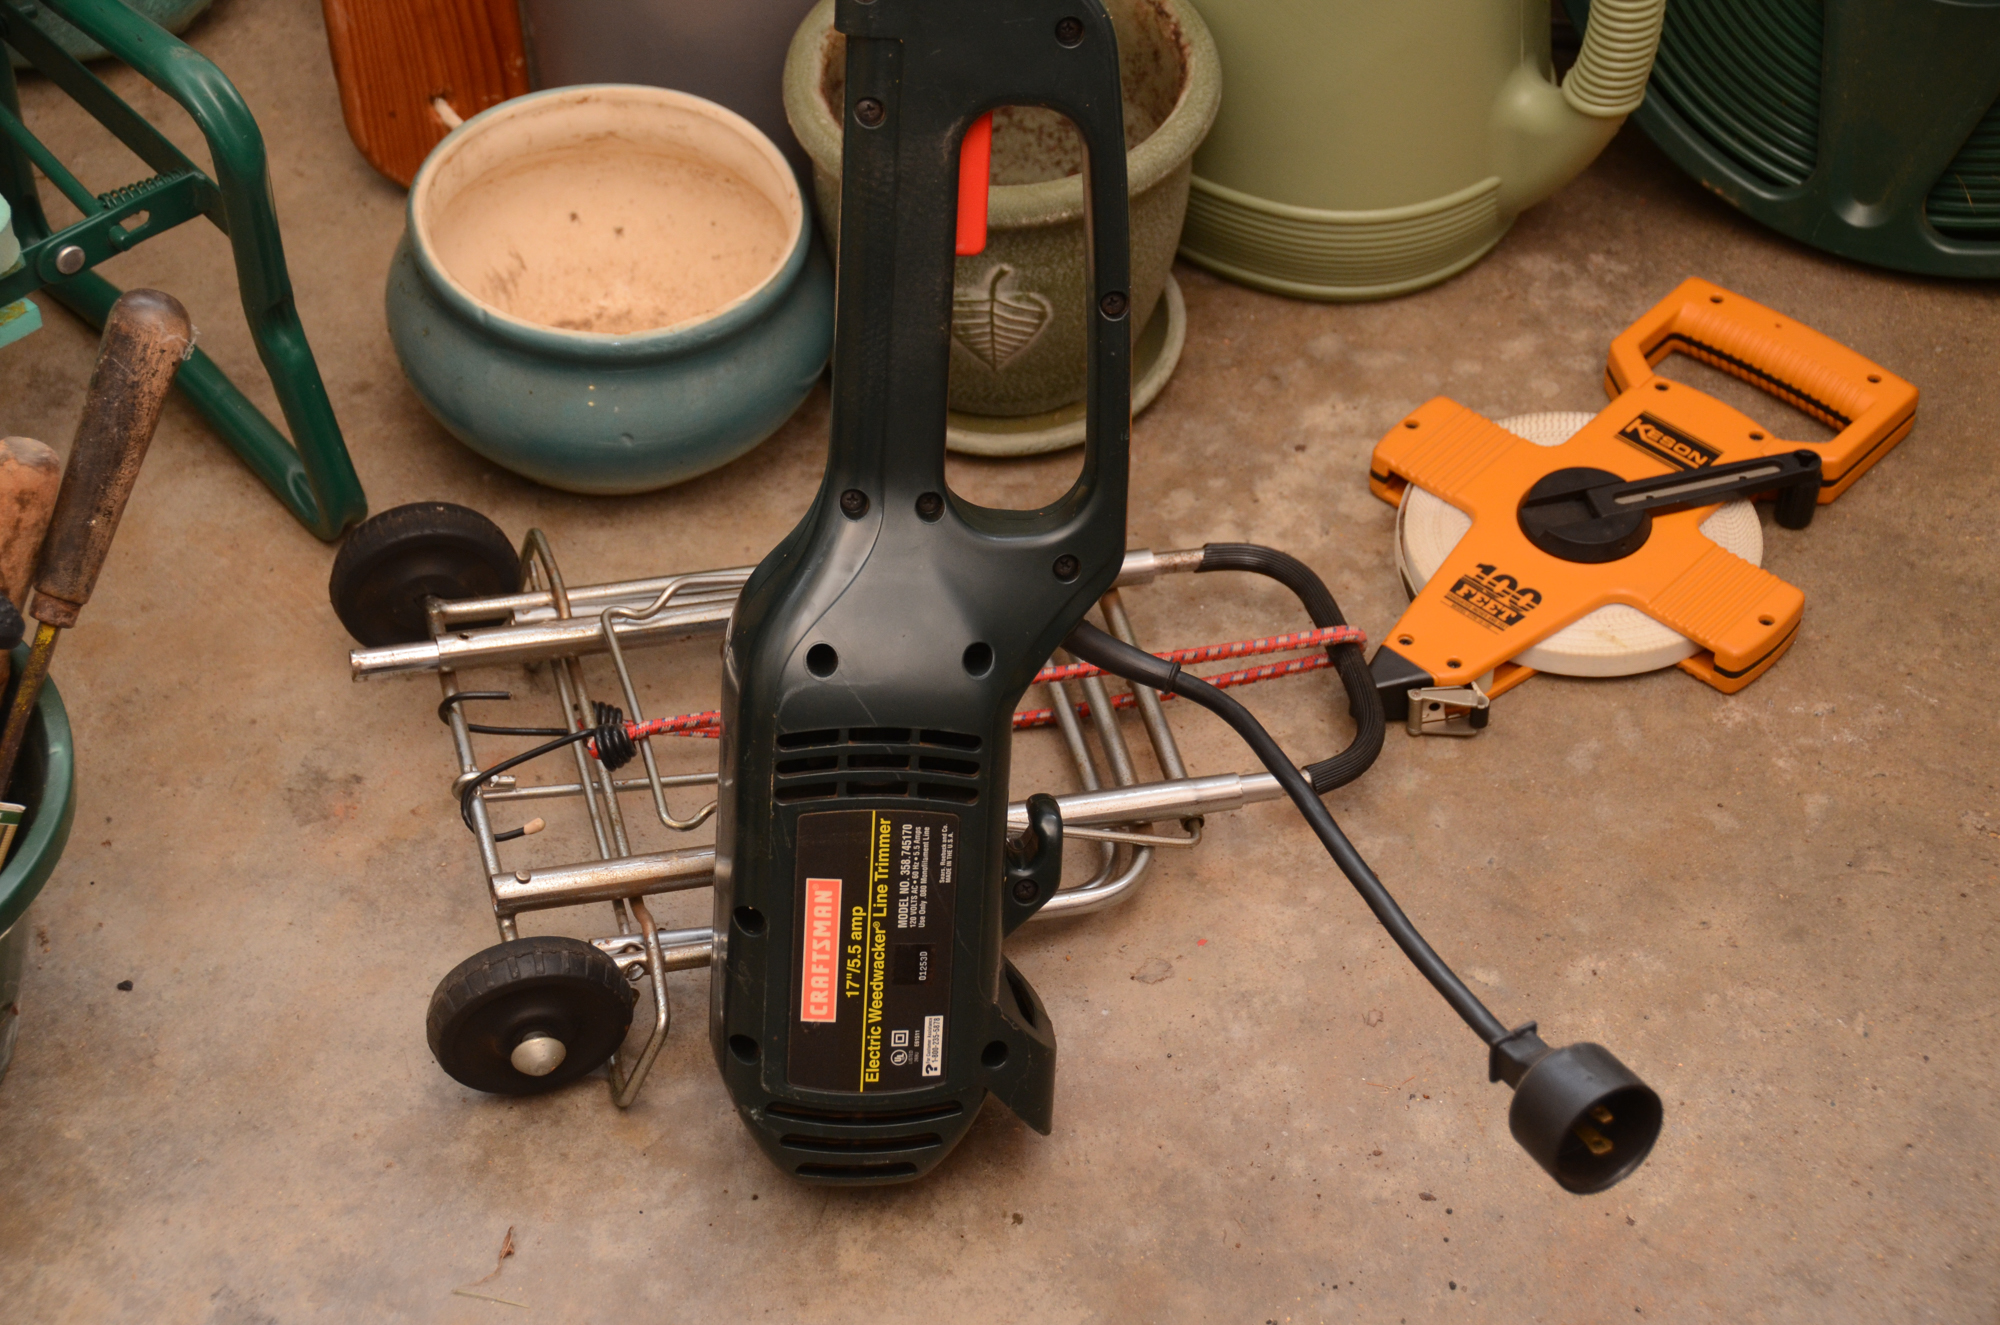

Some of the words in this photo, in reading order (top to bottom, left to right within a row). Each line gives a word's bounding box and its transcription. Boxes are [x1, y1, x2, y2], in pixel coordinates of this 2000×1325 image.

[1625, 417, 1708, 469] KESON
[1455, 583, 1519, 623] FEET
[1464, 563, 1542, 613] 100
[875, 818, 891, 882] Trimmer
[901, 824, 912, 876] 358.745170
[914, 826, 922, 844] Amps
[922, 827, 930, 840] Line
[912, 862, 919, 870] Hz
[912, 871, 919, 879] 60
[920, 842, 929, 884] Monofilament
[873, 884, 889, 917] Line
[900, 878, 910, 894] NO.
[912, 885, 918, 894] AC
[851, 906, 867, 940] amp
[898, 897, 909, 928] MODEL
[920, 900, 928, 915] Only
[809, 890, 833, 1016] CRAFTSMAN
[865, 1026, 882, 1082] Electric
[932, 1018, 940, 1063] 1-800-235-5878
